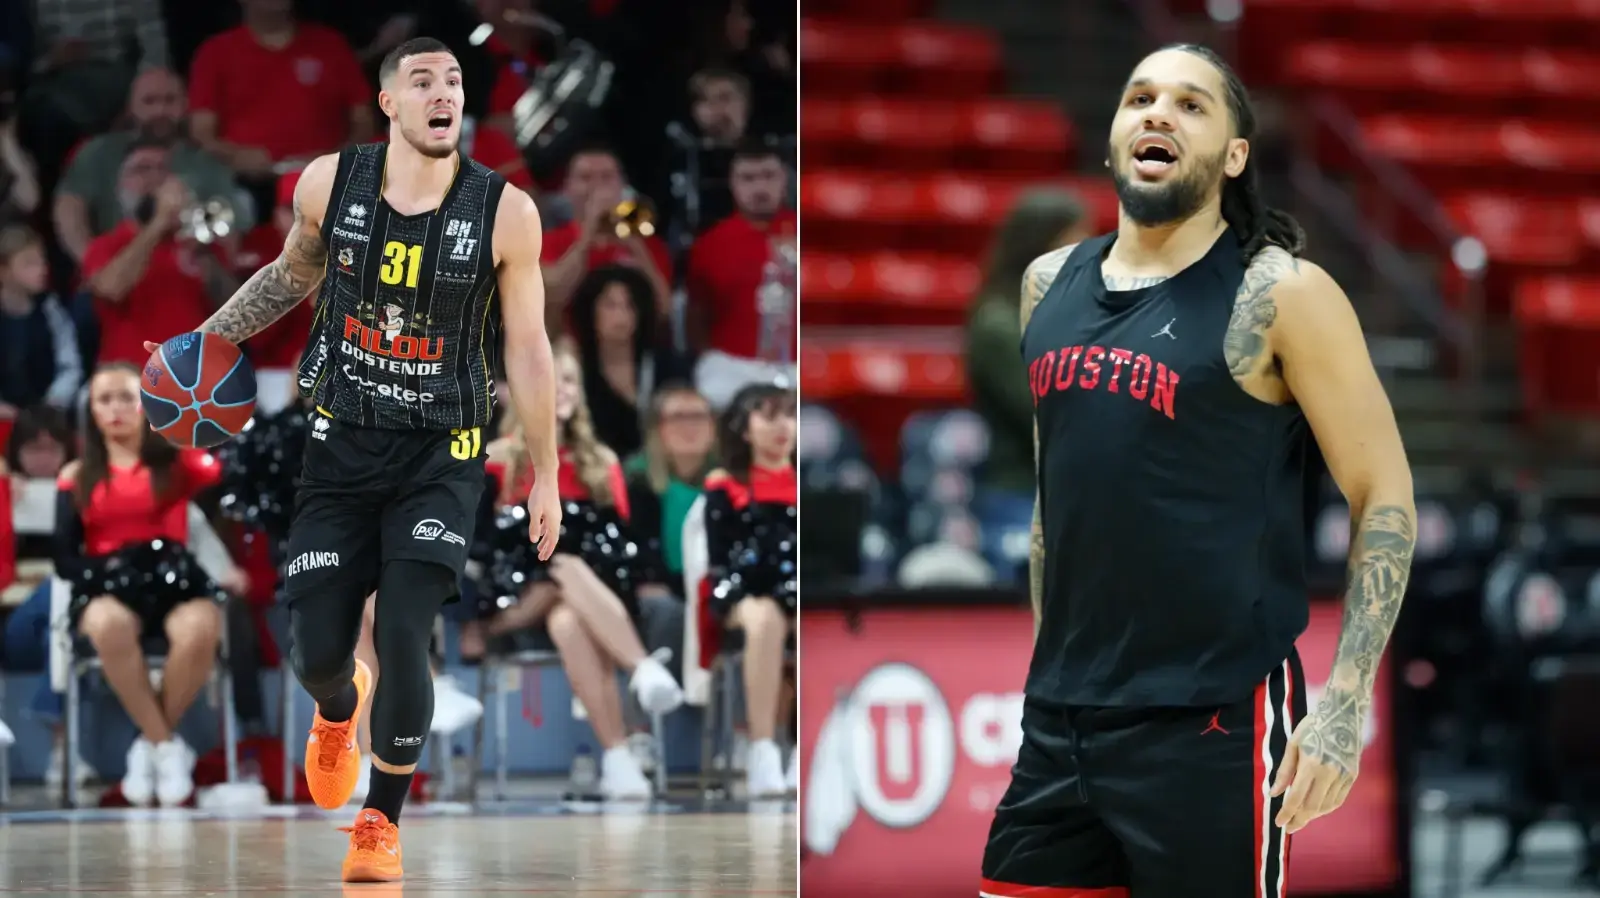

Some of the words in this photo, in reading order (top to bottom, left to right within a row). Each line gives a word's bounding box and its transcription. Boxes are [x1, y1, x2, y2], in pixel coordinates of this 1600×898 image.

[380, 241, 422, 288] 31
[343, 313, 444, 361] FILOU
[340, 340, 443, 376] OOSTENDE
[450, 427, 481, 461] 31
[288, 551, 340, 577] DEFRANCQ
[868, 703, 924, 800] U
